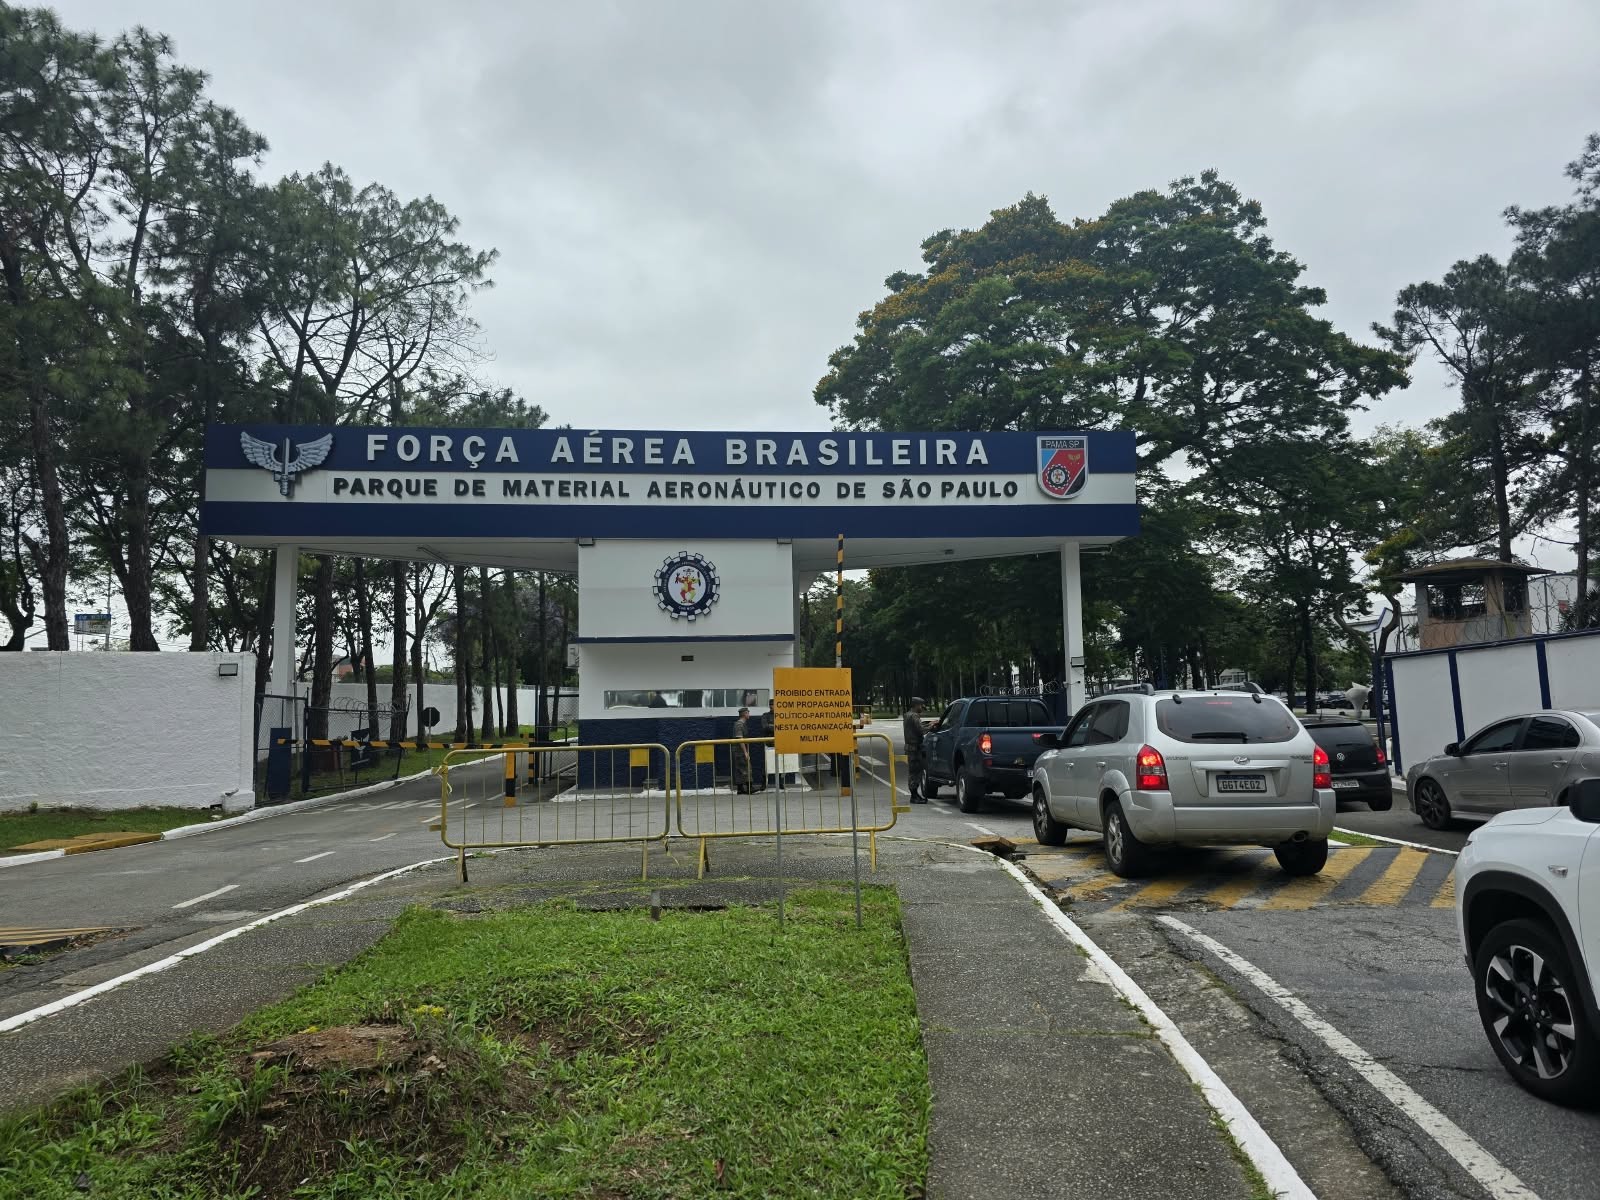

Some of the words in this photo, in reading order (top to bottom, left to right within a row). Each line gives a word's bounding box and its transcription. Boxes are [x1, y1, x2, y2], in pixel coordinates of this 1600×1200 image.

[1045, 440, 1067, 448] PAMA
[1069, 440, 1080, 448] SP
[366, 434, 520, 468] FORÇA
[550, 430, 696, 465] AÉREA
[726, 437, 989, 466] BRASILEIRA
[333, 477, 438, 499] PARQUE
[454, 478, 486, 497] DE
[503, 479, 630, 498] MATERIAL
[647, 478, 821, 499] AERONÁUTICO
[837, 482, 867, 498] DE
[882, 478, 932, 499] SÃO
[941, 481, 1019, 498] PAULO
[775, 689, 813, 697] PROIBIDO
[814, 689, 850, 697] ENTRADA
[774, 723, 799, 731] NESTA
[800, 722, 853, 731] ORGANIZAÇÃO
